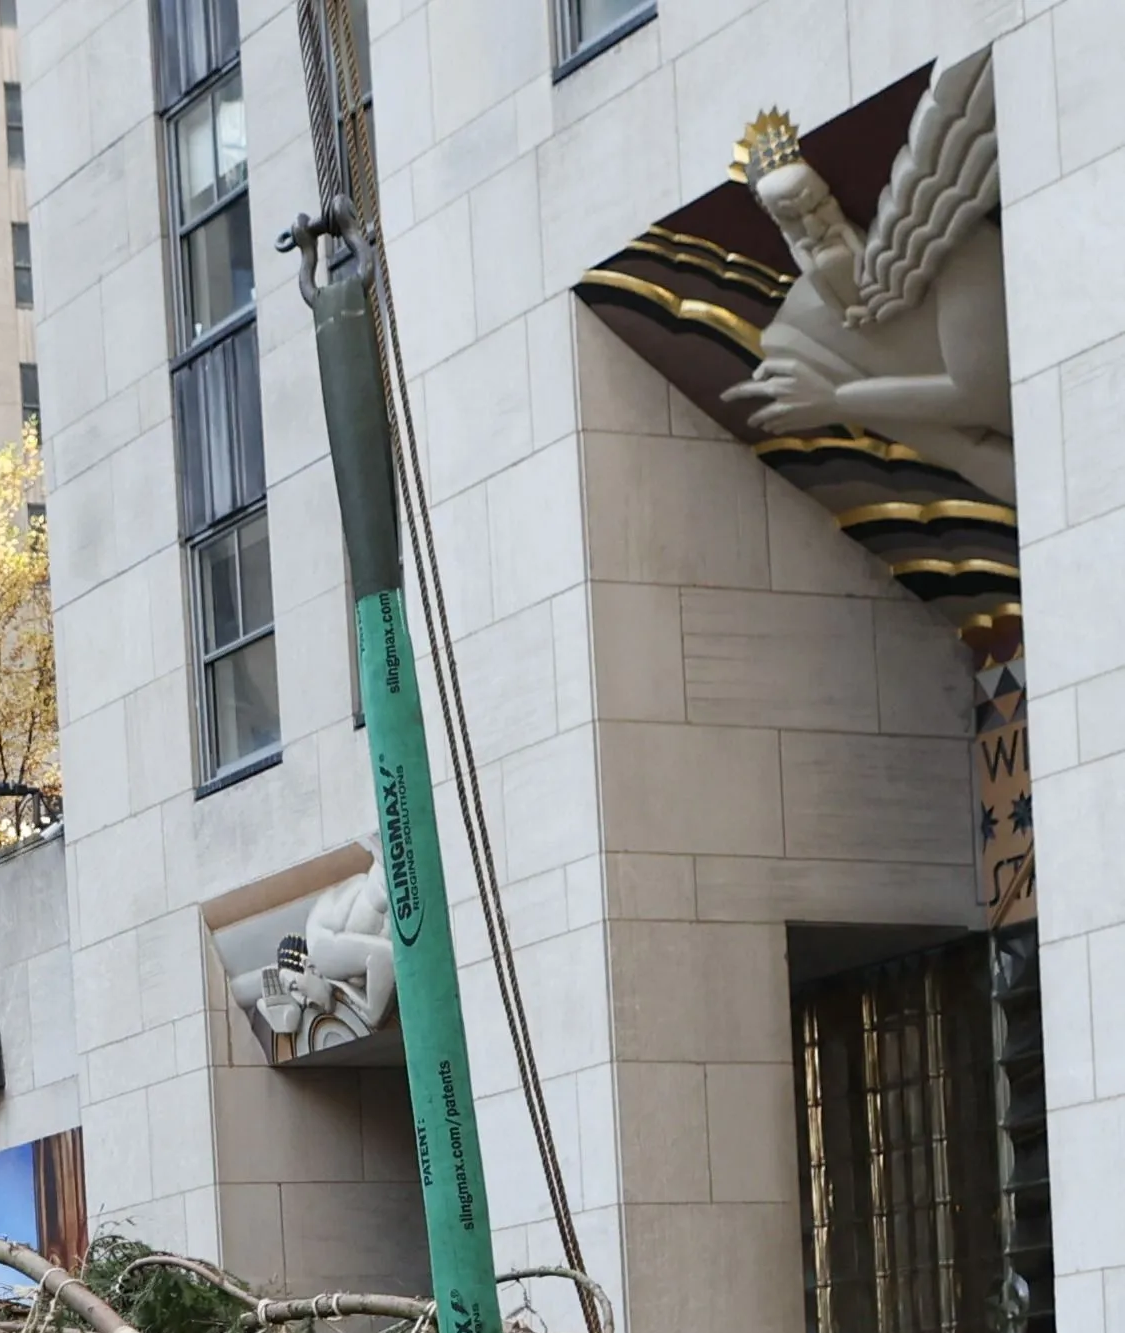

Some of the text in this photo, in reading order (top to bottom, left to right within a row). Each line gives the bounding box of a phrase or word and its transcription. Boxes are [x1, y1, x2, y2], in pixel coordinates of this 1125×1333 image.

[378, 590, 401, 694] slingmax.com
[397, 765, 420, 911] RIGGING SOLUTIONS
[417, 1118, 433, 1187] PATENT:
[438, 1059, 475, 1231] slingmax.com/patents
